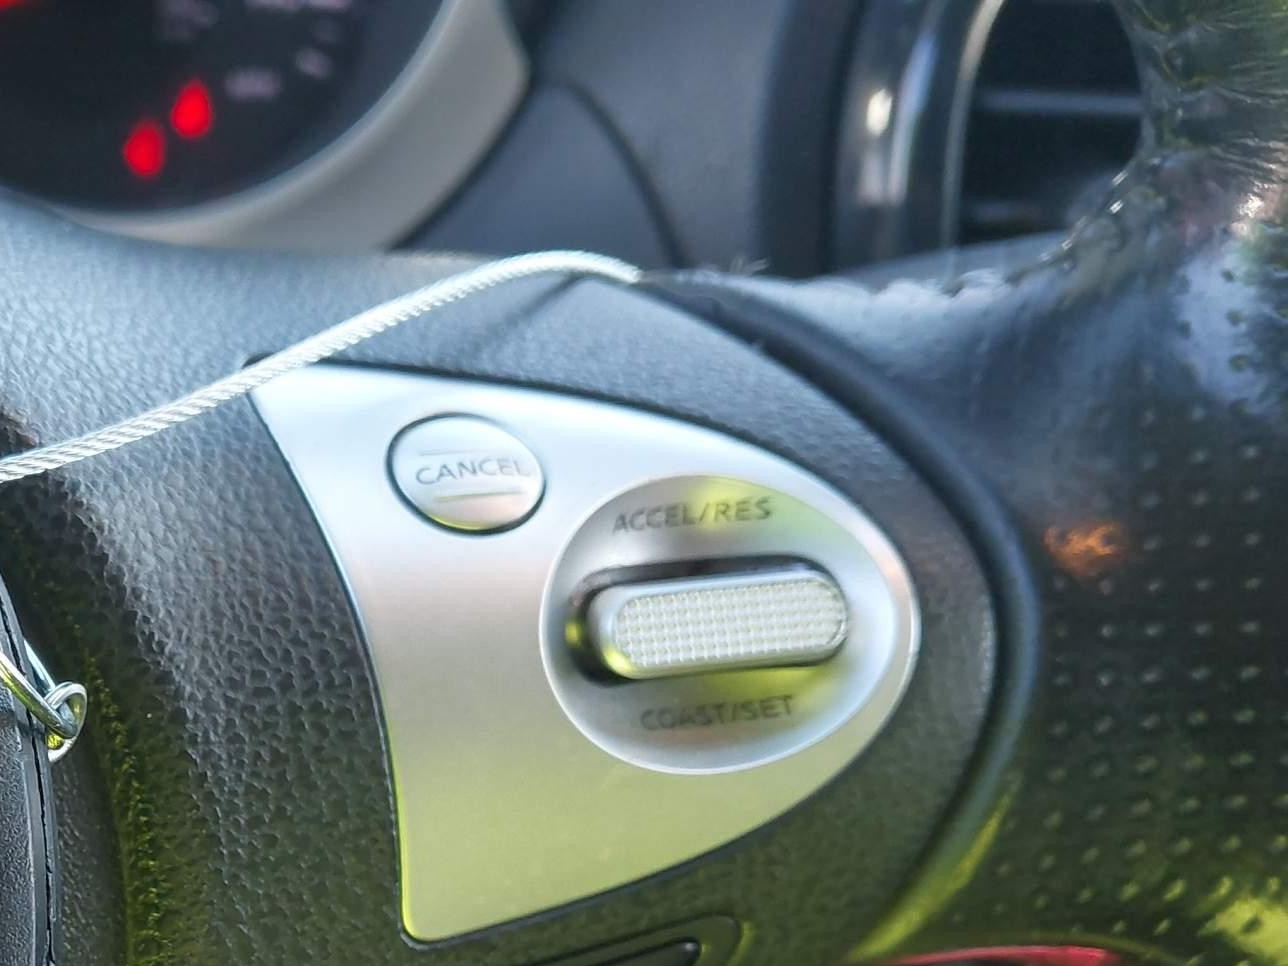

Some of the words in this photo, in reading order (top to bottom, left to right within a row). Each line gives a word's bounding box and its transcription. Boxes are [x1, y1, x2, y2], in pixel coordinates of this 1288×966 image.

[416, 458, 530, 485] CANCEL
[614, 496, 772, 532] ACCEL/RES
[640, 695, 793, 731] COAST/SET
